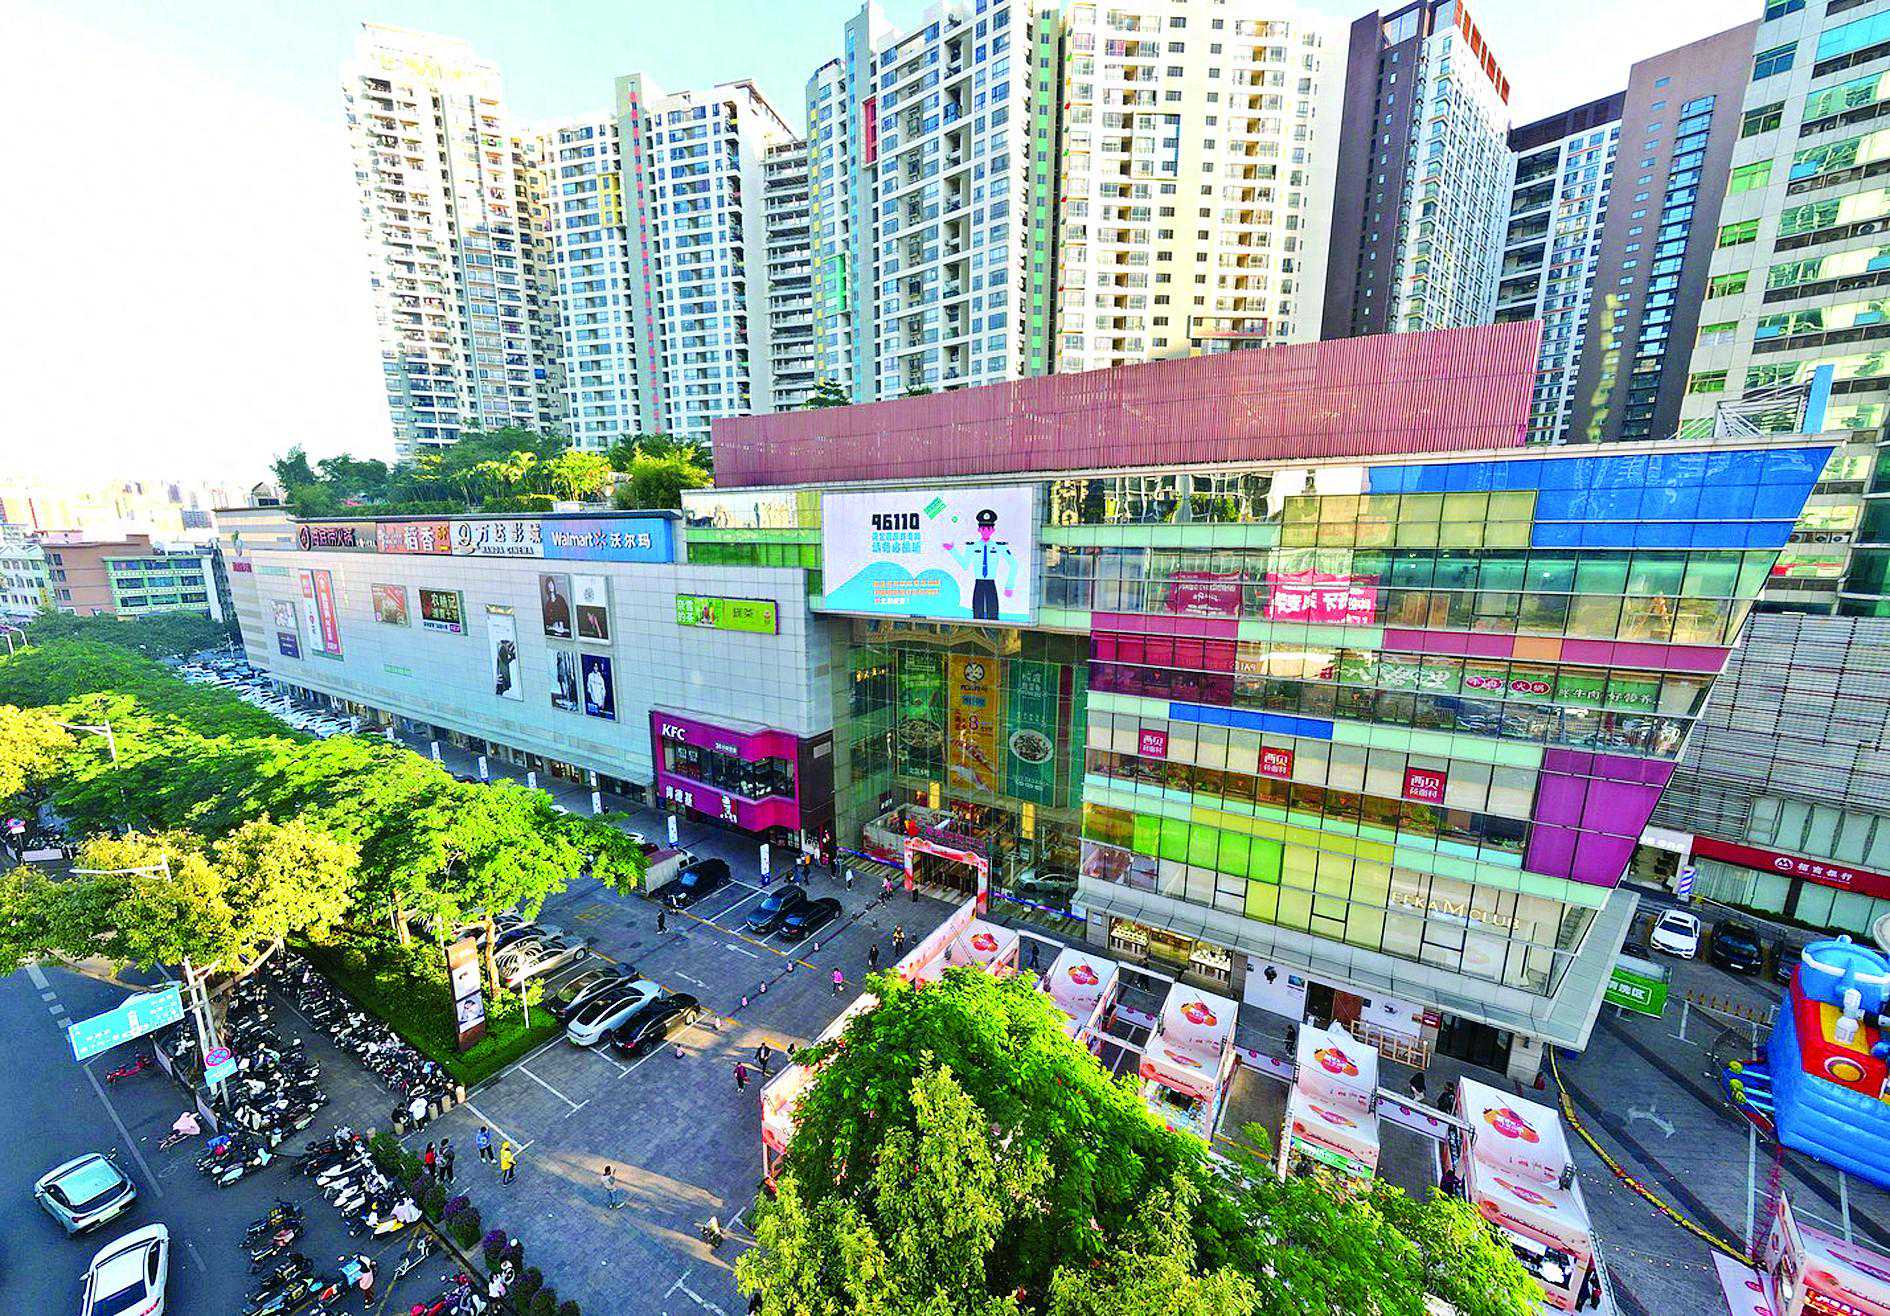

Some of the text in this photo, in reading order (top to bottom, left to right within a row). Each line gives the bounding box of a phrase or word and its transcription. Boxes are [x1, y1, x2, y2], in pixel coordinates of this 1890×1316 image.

[872, 513, 920, 530] 96110
[552, 531, 594, 547] Walmart
[610, 533, 650, 549] 沃尔玛
[662, 723, 686, 741] KFC
[1143, 735, 1163, 747] 西贝
[1264, 753, 1288, 766] 西贝
[1410, 774, 1440, 790] 西贝
[1469, 909, 1520, 930] CLUB
